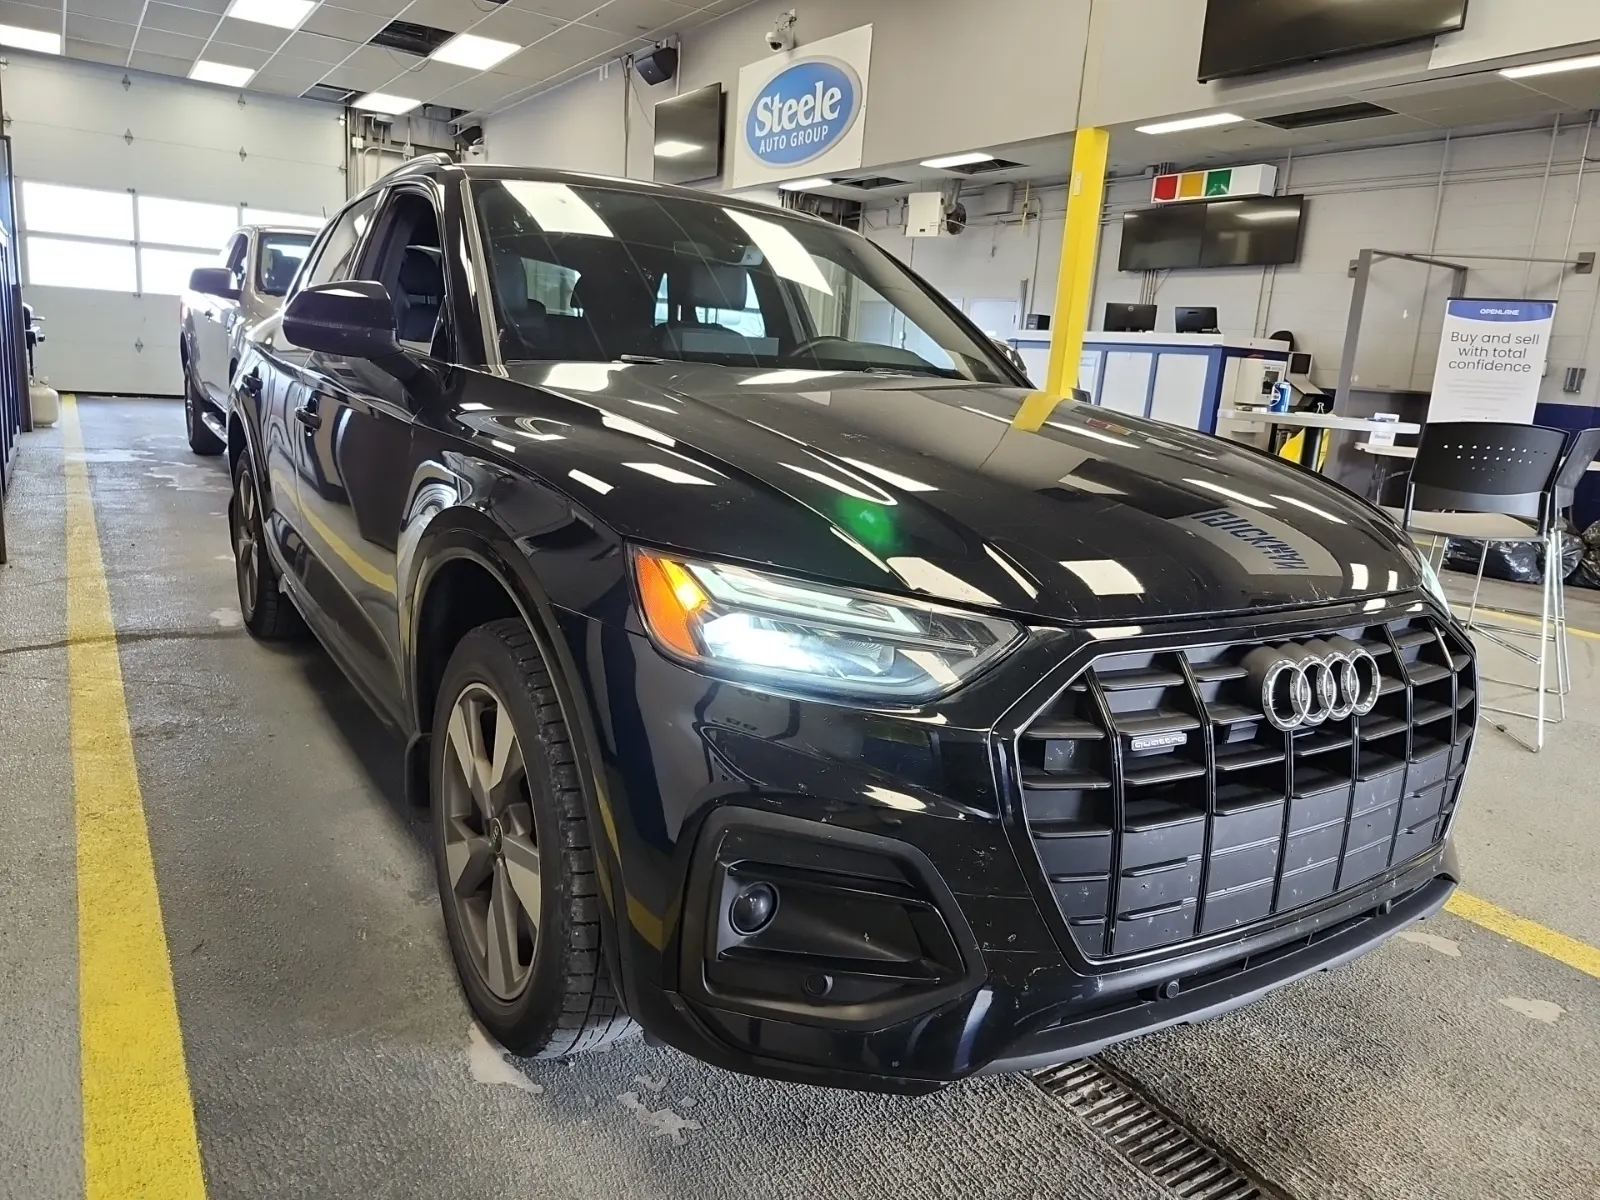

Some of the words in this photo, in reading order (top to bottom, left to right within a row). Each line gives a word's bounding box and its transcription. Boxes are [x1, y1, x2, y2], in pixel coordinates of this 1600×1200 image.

[754, 80, 842, 137] Steele
[759, 135, 787, 154] AUTO
[790, 125, 829, 147] GROUP
[1479, 308, 1520, 316] OPENLANE
[1450, 331, 1479, 346] Buy
[1481, 333, 1512, 344] and
[1514, 334, 1540, 345] sell
[1458, 346, 1489, 357] with
[1492, 347, 1527, 359] total
[1448, 359, 1532, 373] confidence
[1134, 736, 1185, 749] quattro
